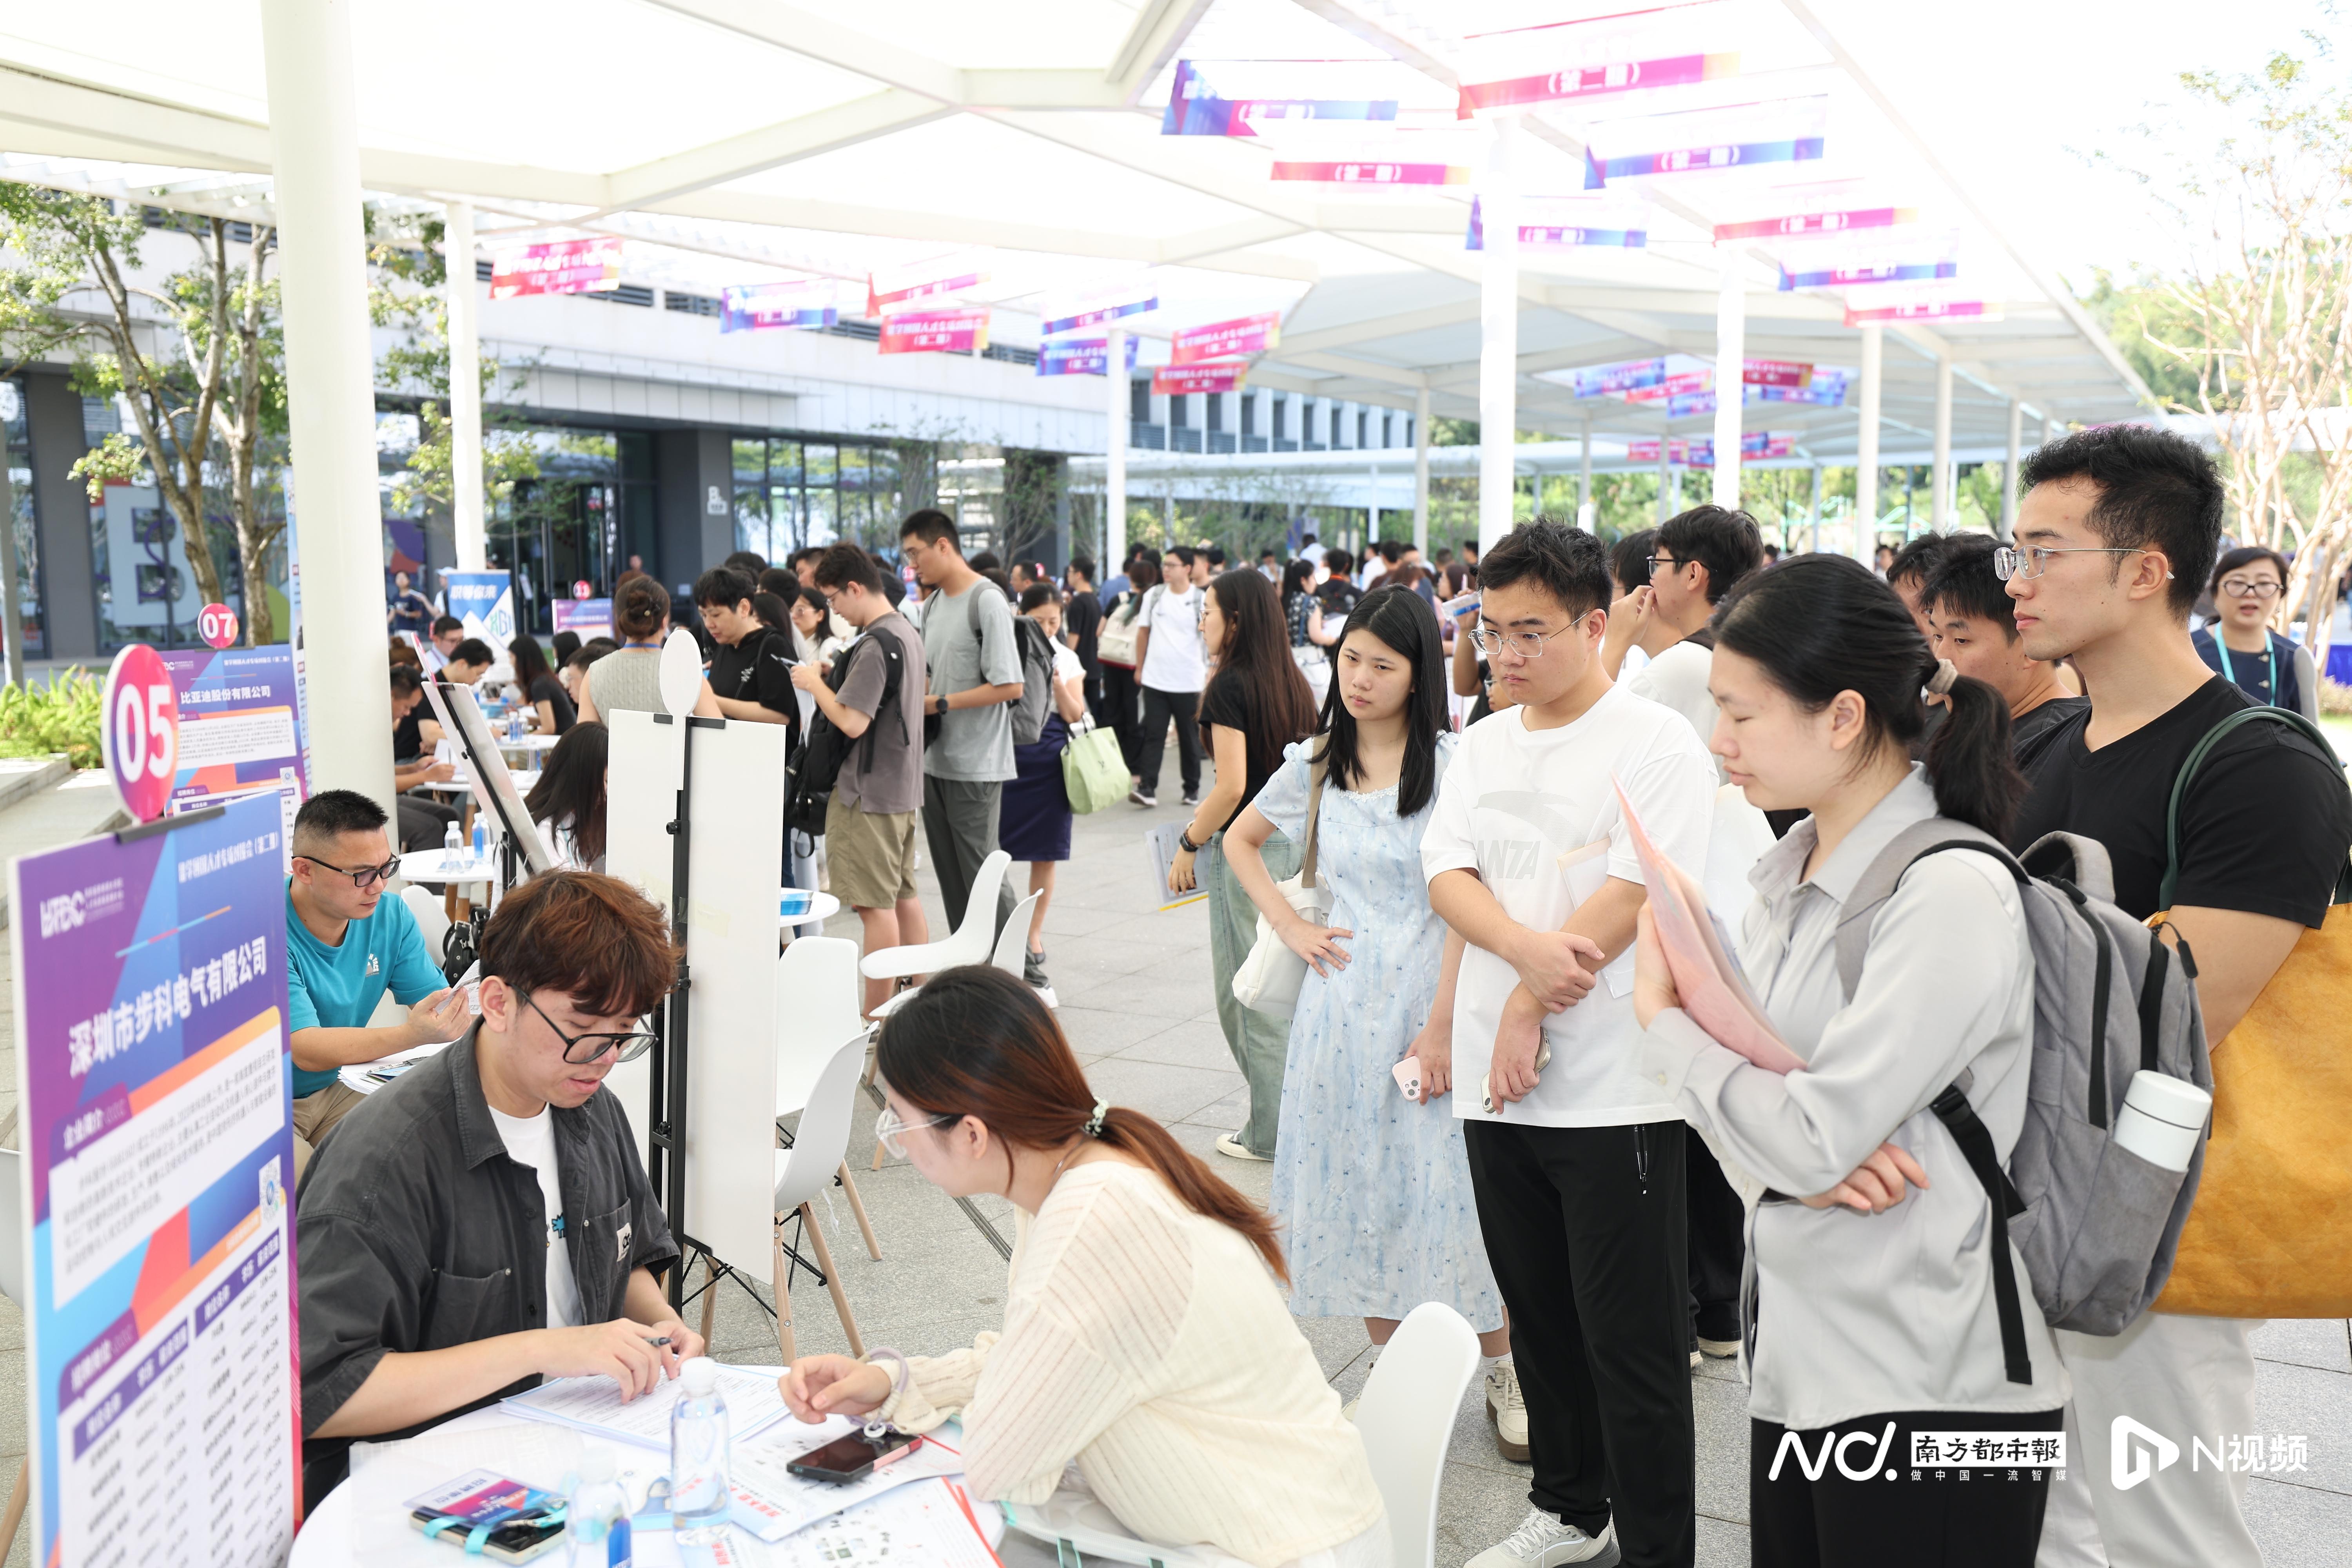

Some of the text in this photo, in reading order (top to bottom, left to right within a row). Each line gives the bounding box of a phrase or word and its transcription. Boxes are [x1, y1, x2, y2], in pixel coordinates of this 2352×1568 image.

[451, 584, 497, 600] 职等你来
[202, 613, 233, 639] 07
[180, 685, 270, 704] 比亚迪股份有限公司
[116, 683, 173, 782] 05
[1477, 840, 1541, 879] ANTA
[69, 935, 267, 1078] 深圳市步科电气有限公司
[64, 1107, 104, 1151] 企业简介
